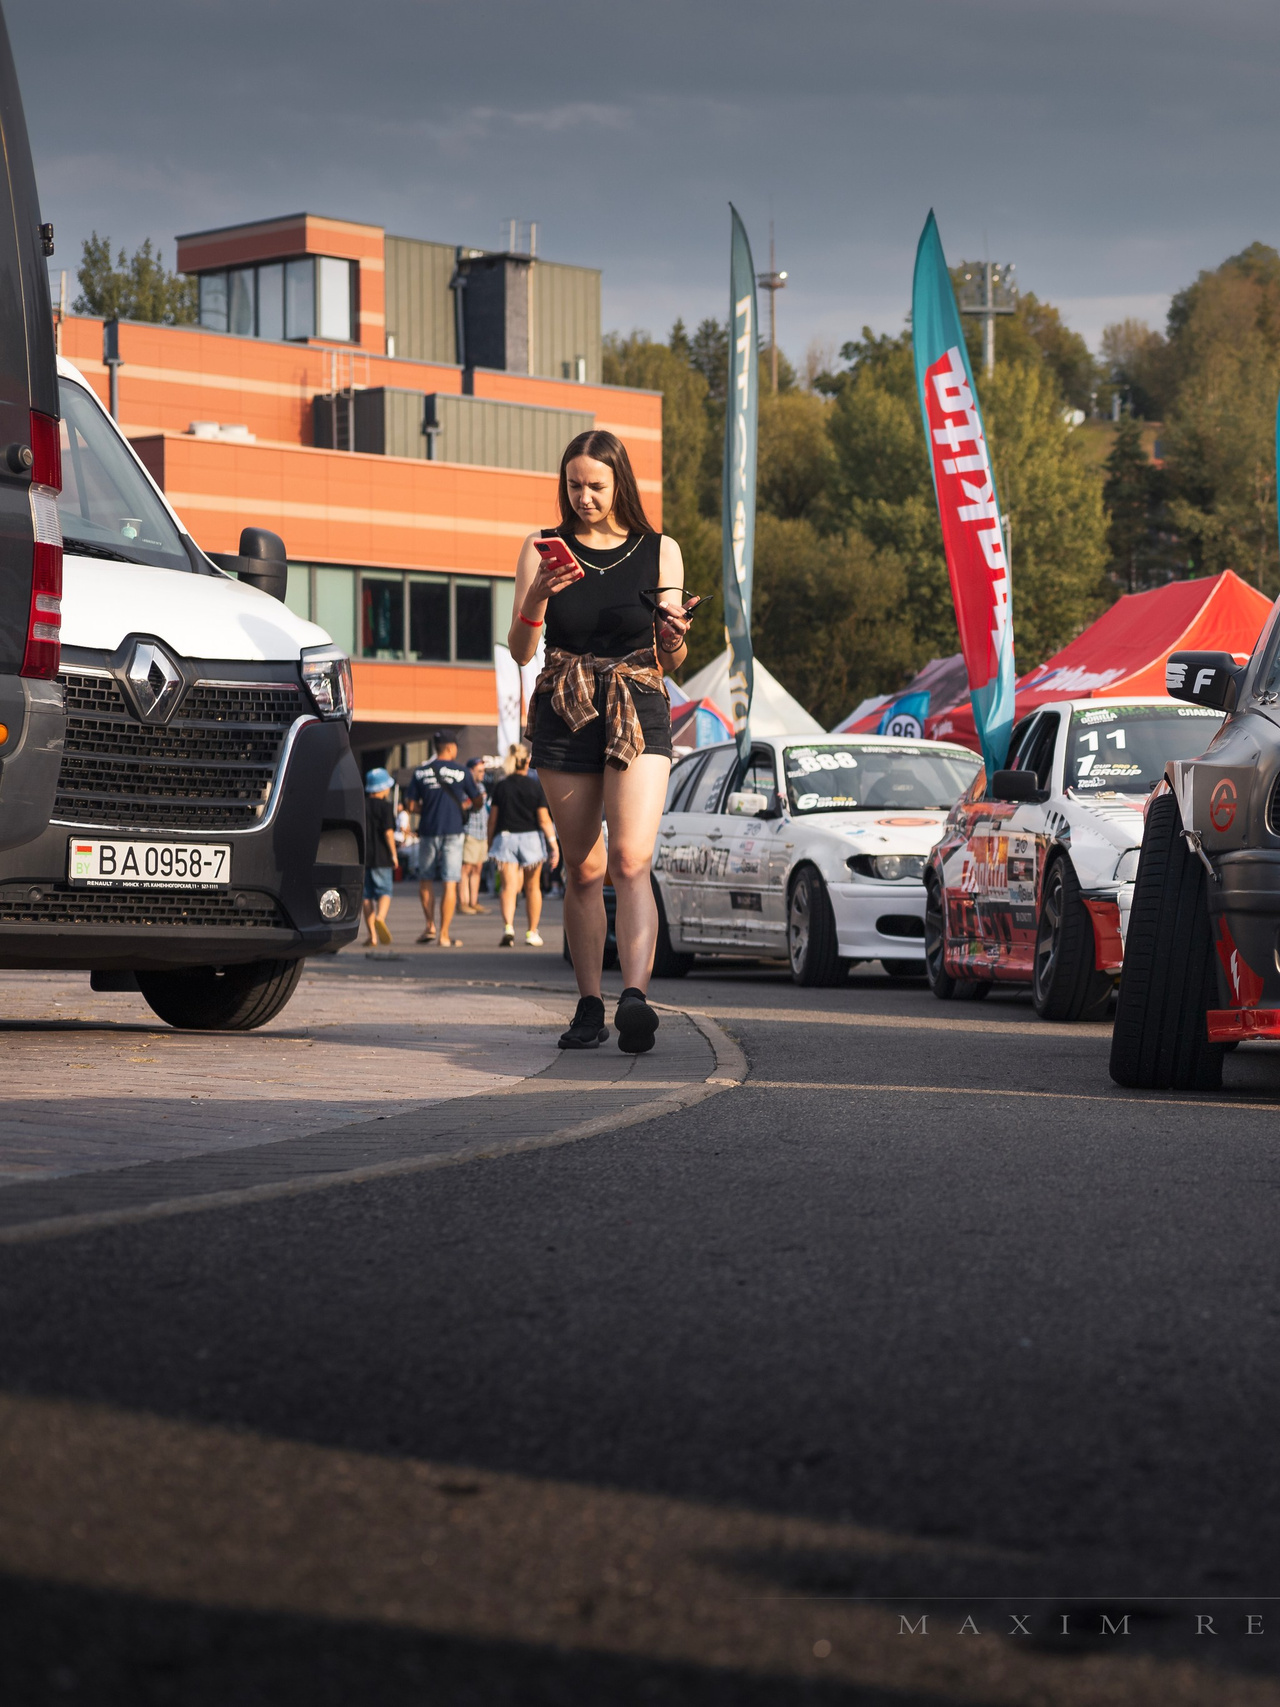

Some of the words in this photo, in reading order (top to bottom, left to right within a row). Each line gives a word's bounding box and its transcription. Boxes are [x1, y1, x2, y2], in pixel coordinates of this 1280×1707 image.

[892, 722, 914, 738] 86
[1079, 729, 1126, 751] 11
[798, 752, 858, 772] 888
[1077, 754, 1096, 776] 1
[76, 862, 91, 875] BY
